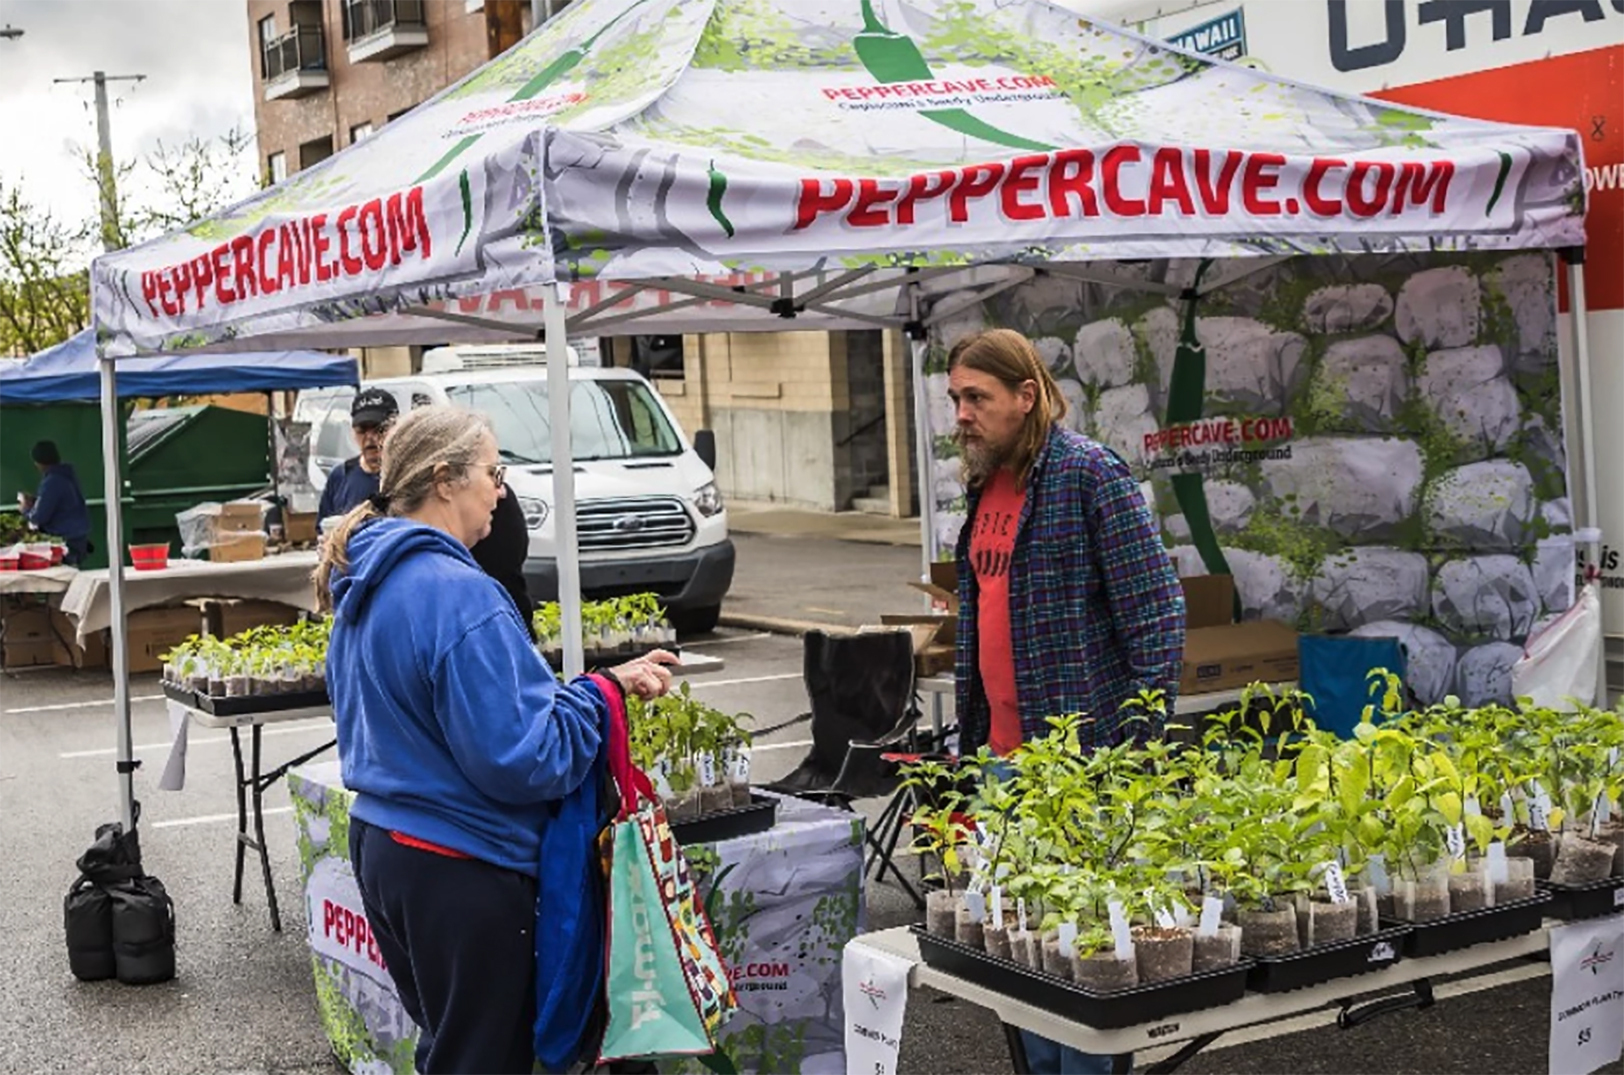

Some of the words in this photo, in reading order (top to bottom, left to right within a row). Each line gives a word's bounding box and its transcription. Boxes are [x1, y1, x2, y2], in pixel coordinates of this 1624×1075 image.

[1328, 0, 1624, 72] U-HA
[821, 75, 1058, 101] PEPPERCAVE.COM
[793, 145, 1455, 230] PEPPERCAVE.COM
[141, 186, 431, 318] PEPPERCAVE.COM
[1212, 445, 1292, 464] Underground
[1600, 545, 1619, 570] is
[324, 898, 387, 971] PEPPE
